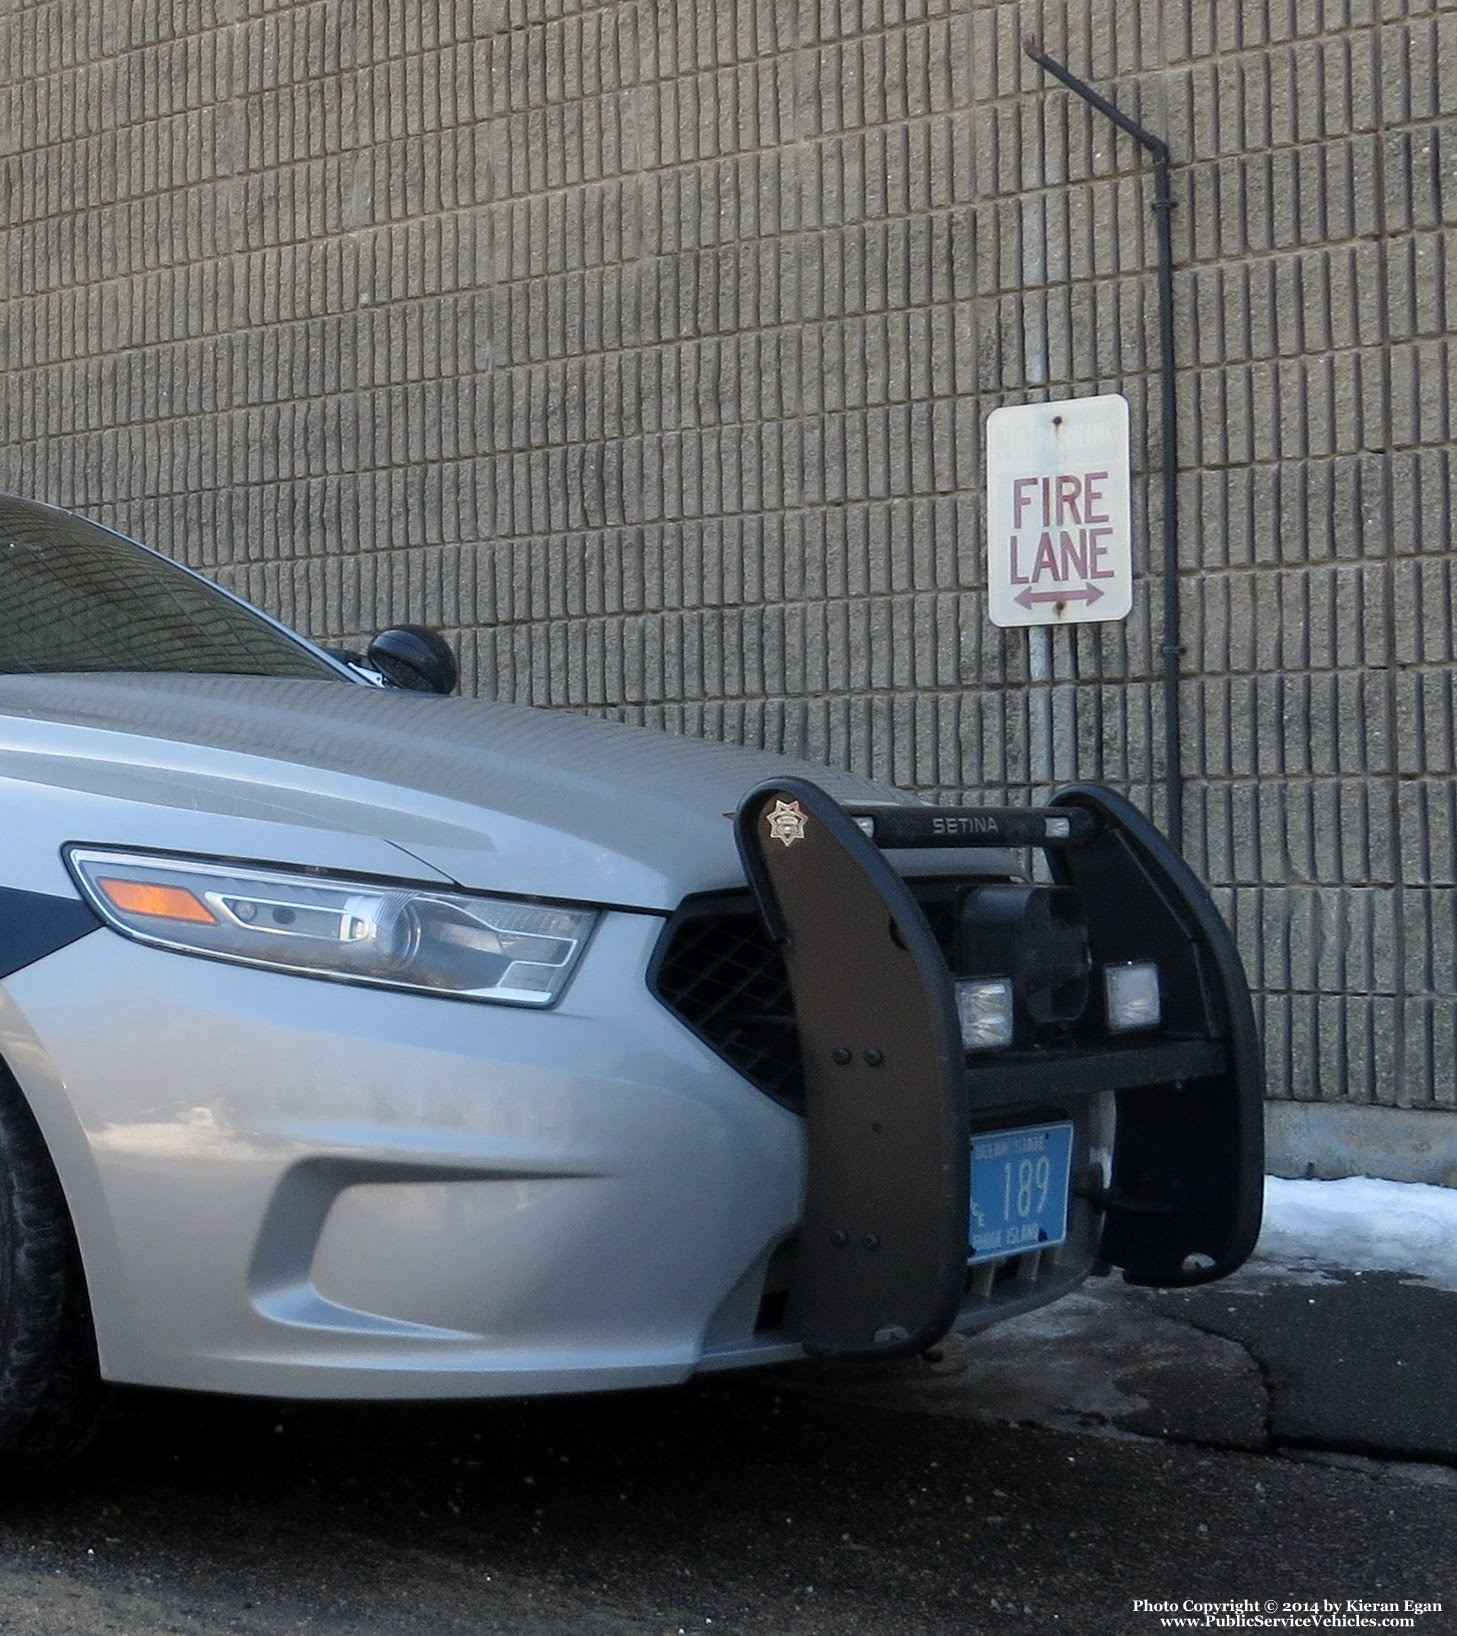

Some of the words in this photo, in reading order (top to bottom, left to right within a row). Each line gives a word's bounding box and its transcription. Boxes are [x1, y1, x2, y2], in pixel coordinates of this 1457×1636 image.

[1013, 471, 1110, 529] FIRE
[1010, 527, 1115, 585] LANE
[932, 816, 1000, 834] SETINA
[1004, 1156, 1050, 1221] 189
